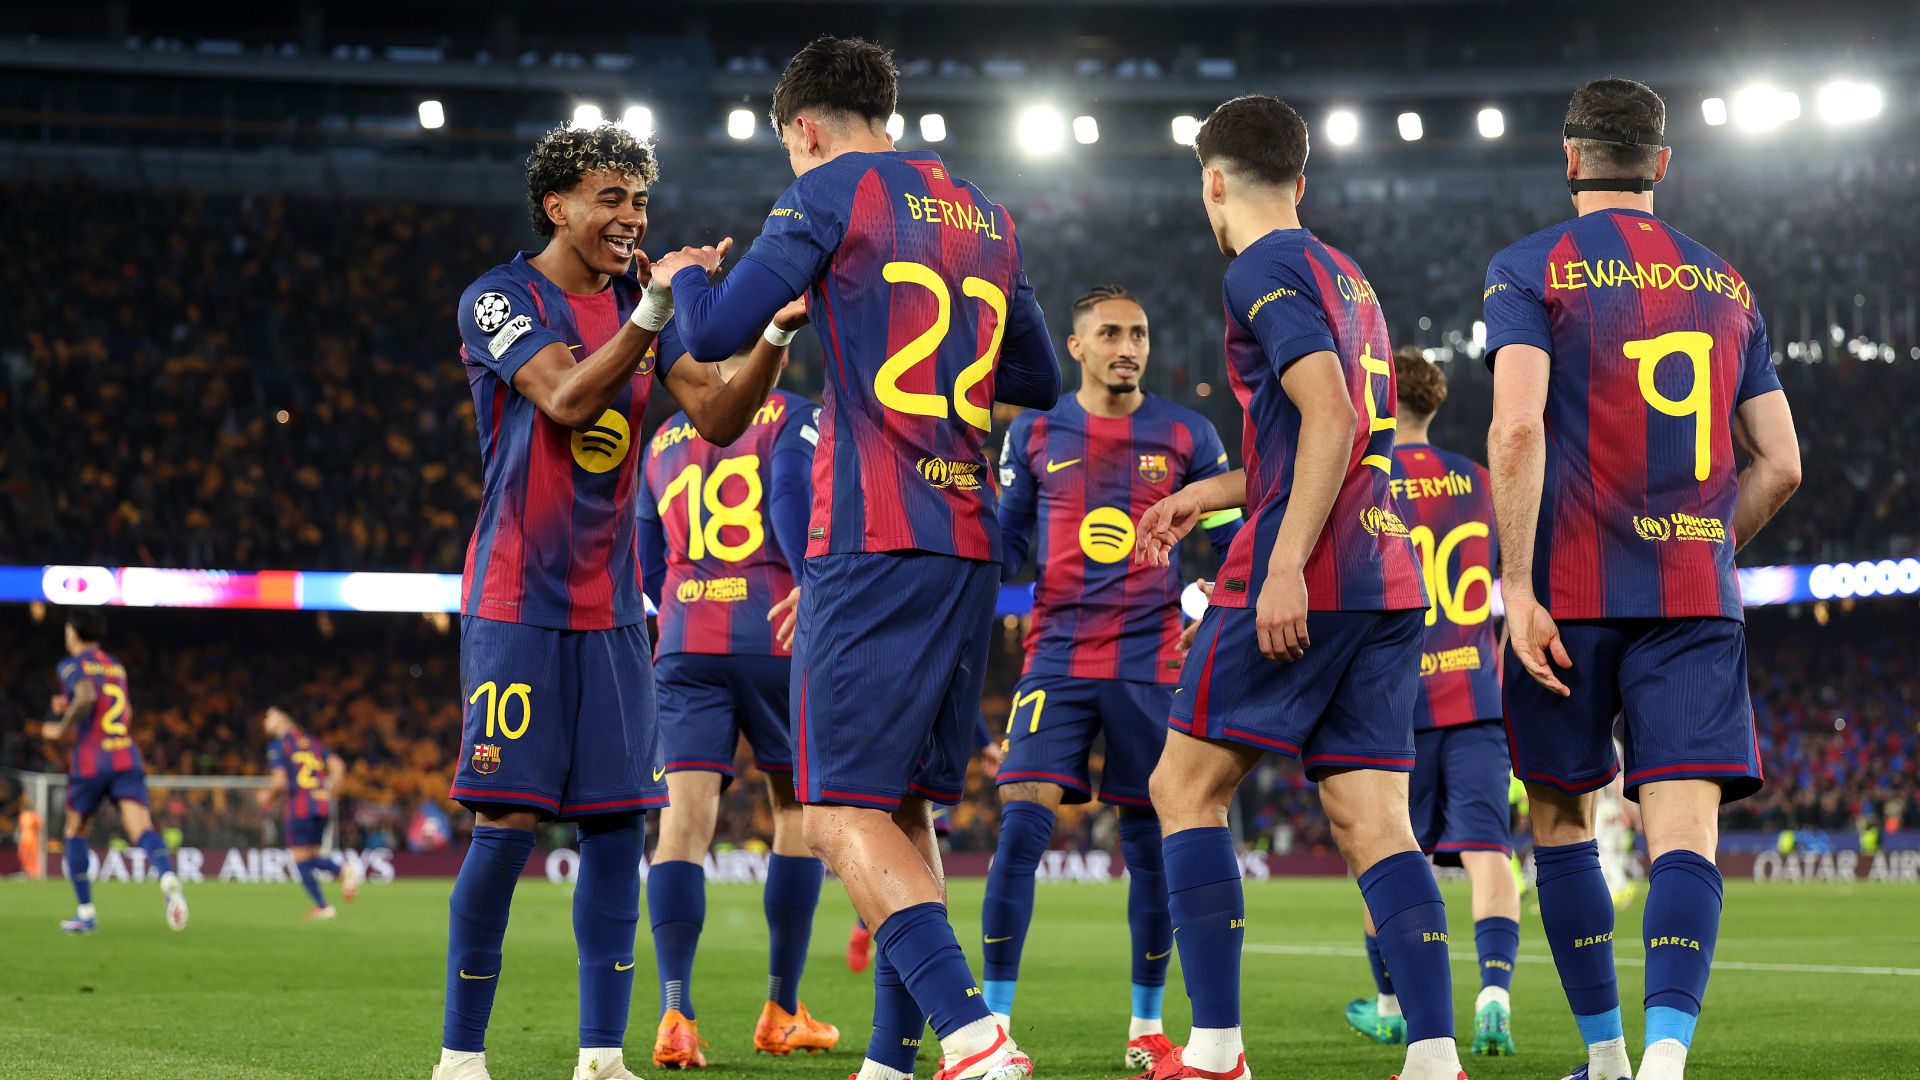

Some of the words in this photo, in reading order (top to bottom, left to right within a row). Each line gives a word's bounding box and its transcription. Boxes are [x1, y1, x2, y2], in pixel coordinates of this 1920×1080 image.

[794, 211, 804, 220] tv
[904, 192, 1002, 240] BERNAL
[1247, 287, 1287, 323] AMBILIGHT
[1550, 259, 1751, 310] LEWANDOWSKI
[874, 261, 1007, 433] 22
[1622, 331, 1714, 482] 9
[657, 453, 764, 564] 18
[1390, 470, 1473, 501] FERMÍN
[1670, 512, 1724, 528] UNHCR
[1675, 524, 1726, 540] ACNUR
[1409, 521, 1492, 627] 16
[101, 682, 128, 736] 2
[470, 680, 532, 740] 10
[1753, 849, 1859, 884] QATAR
